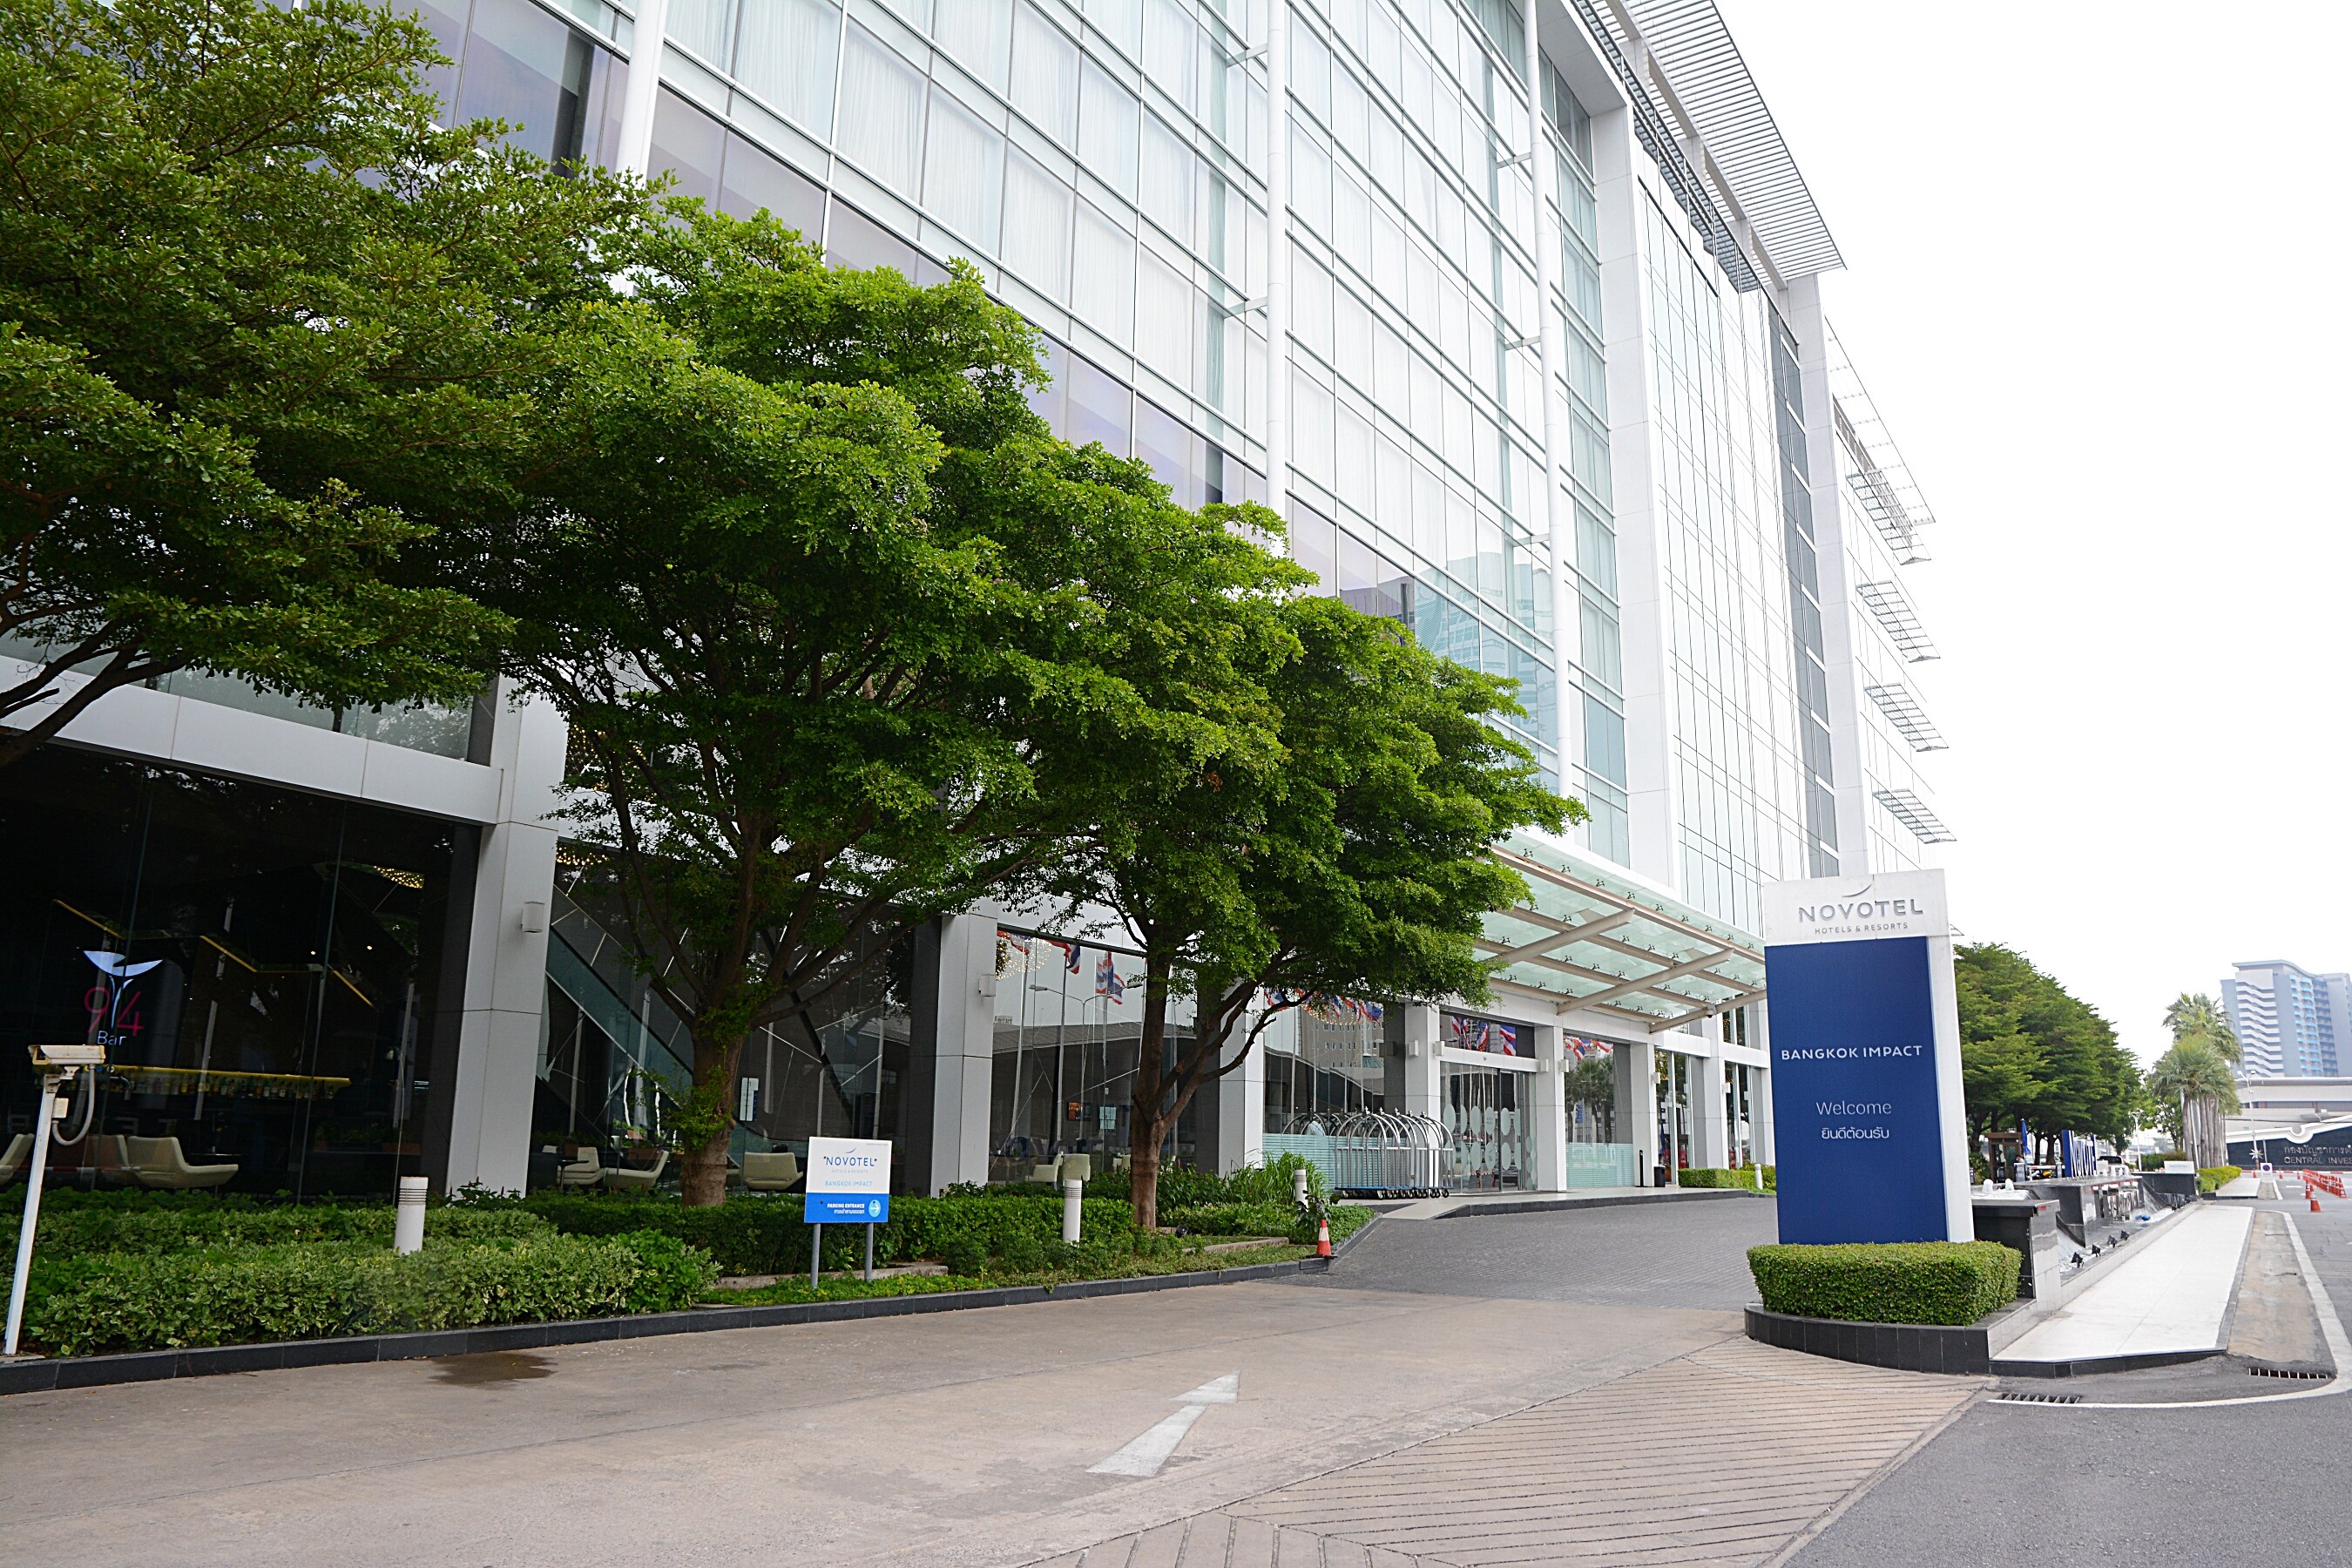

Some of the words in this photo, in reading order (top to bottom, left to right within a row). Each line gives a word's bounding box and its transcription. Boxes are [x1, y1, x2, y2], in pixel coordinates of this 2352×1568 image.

[1799, 899, 1923, 923] NOVOTEL
[1864, 923, 1909, 931] RESORTS
[97, 1031, 127, 1045] Bar
[1781, 1047, 1858, 1060] BANGKOK
[1862, 1045, 1923, 1058] IMPACT
[1815, 1100, 1892, 1115] Welcome
[1821, 1126, 1889, 1139] ยินดีต้อนรับ
[826, 1156, 875, 1166] NOVOTEL
